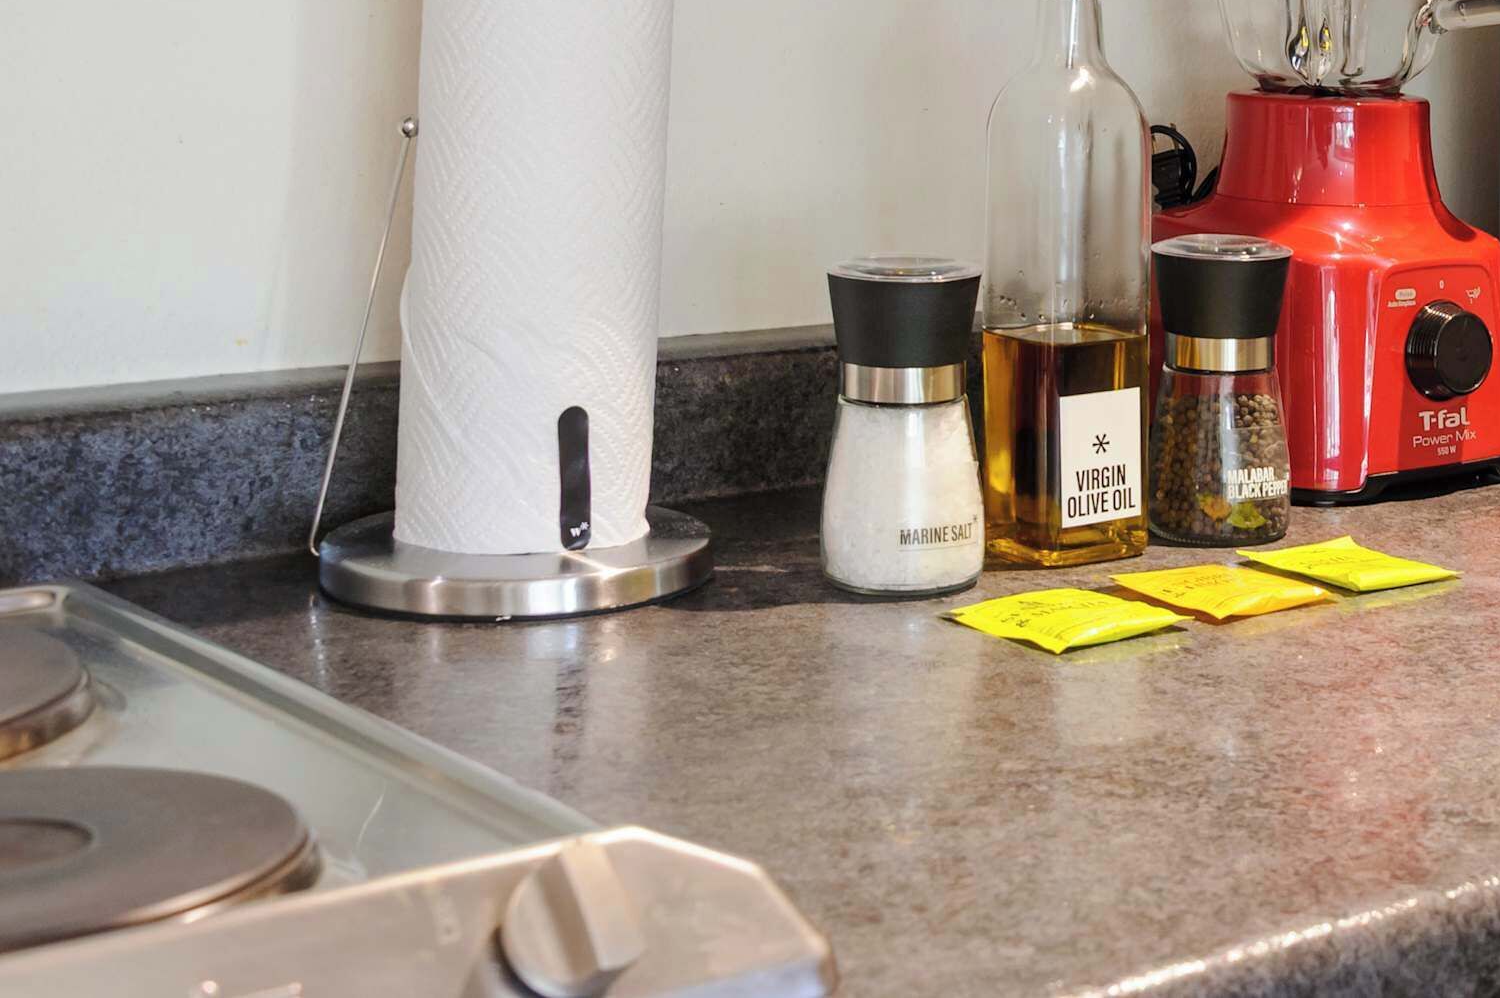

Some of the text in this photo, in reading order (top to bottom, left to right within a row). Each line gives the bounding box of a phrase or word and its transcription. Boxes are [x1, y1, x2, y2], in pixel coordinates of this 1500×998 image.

[1419, 407, 1471, 431] T-fal
[1413, 429, 1477, 448] Power Mix
[1076, 463, 1126, 492] VIRGIN
[1227, 467, 1275, 484] MALABAR
[1067, 487, 1136, 519] OLIVE OIL
[1227, 482, 1262, 500] BLACK
[900, 522, 973, 546] MARINE SALT
